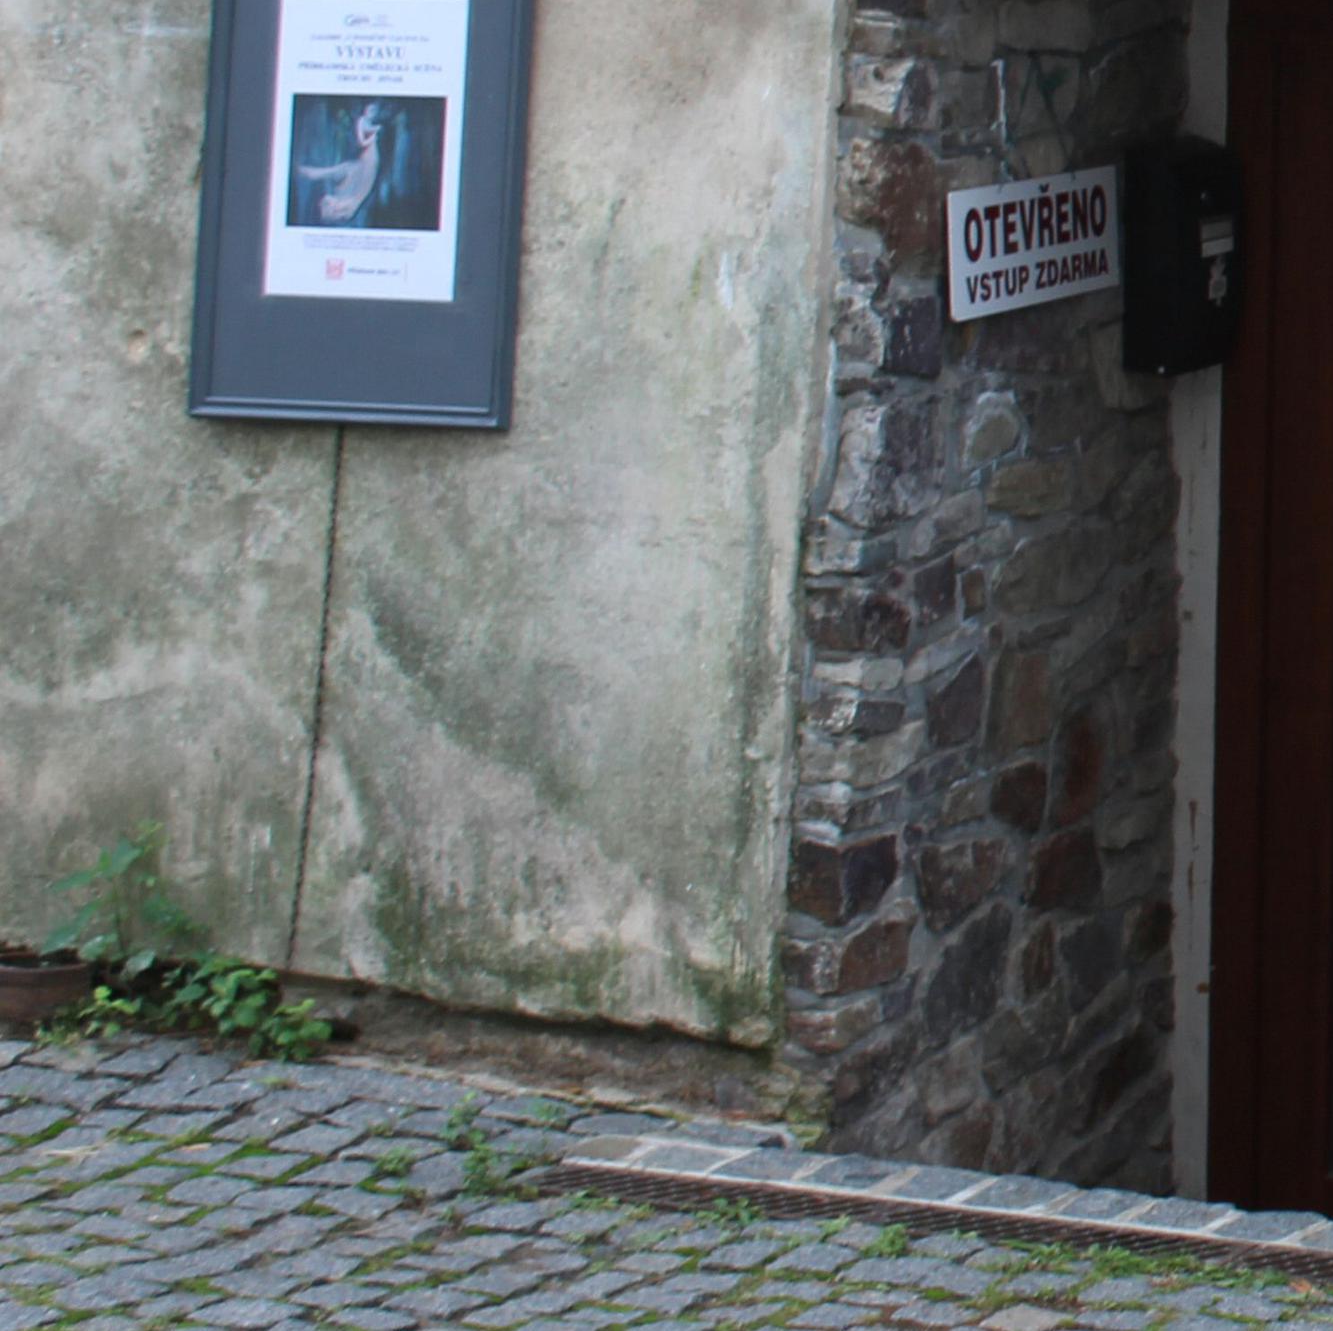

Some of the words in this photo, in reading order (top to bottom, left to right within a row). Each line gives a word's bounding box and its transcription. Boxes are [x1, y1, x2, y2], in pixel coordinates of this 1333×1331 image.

[964, 183, 1107, 263] OTEVŘENO
[966, 264, 1030, 305] VSTUP
[1035, 248, 1110, 291] ZDARMA
